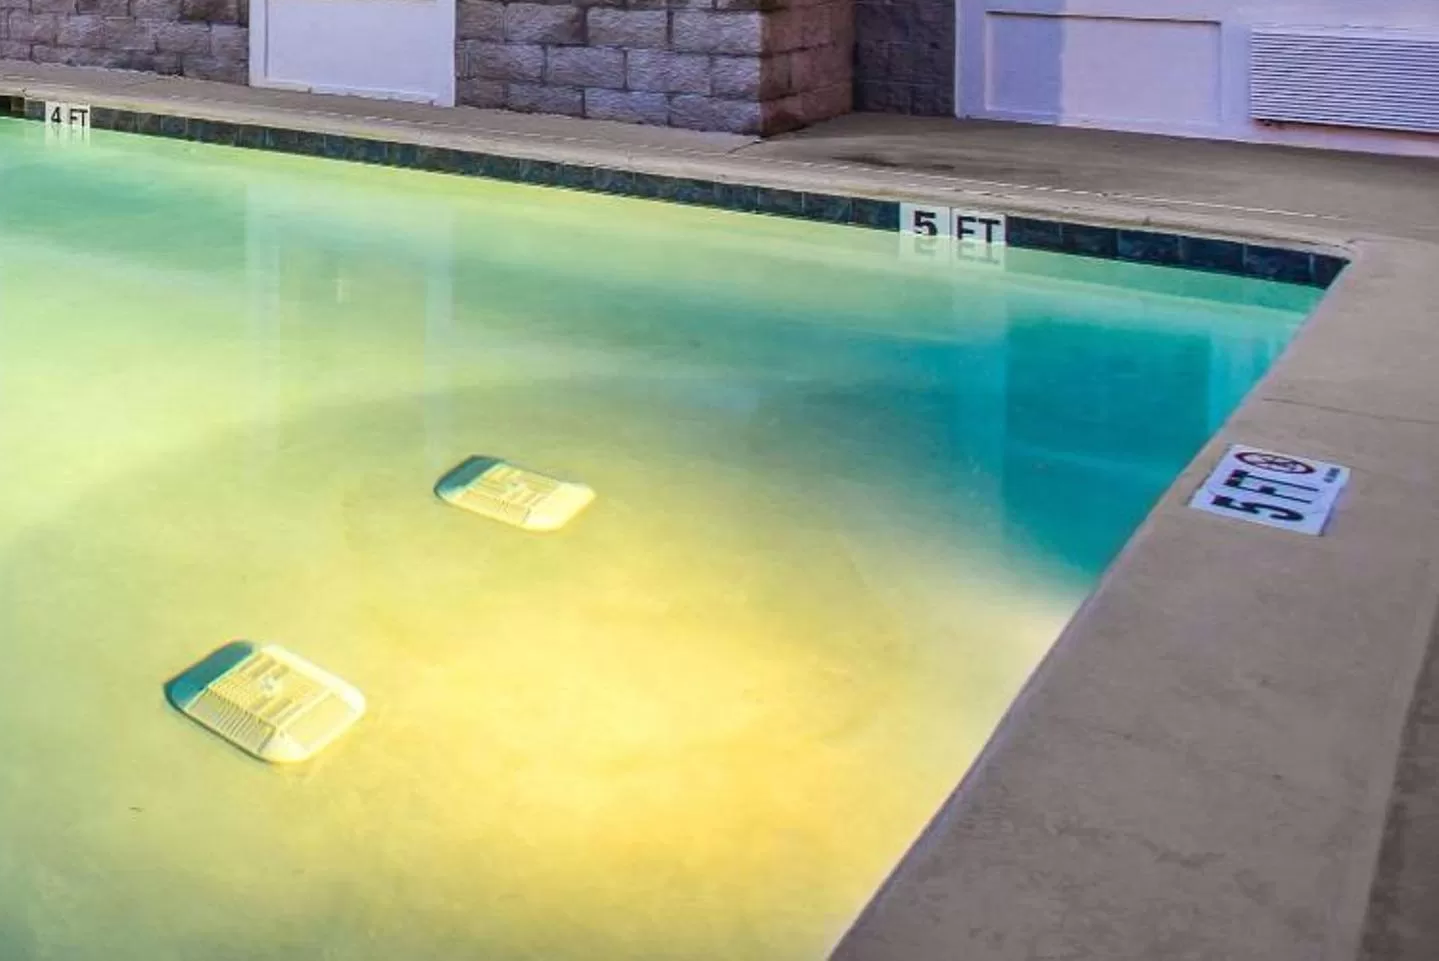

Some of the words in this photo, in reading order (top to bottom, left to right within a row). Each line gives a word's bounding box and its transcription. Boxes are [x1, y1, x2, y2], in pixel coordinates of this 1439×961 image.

[50, 106, 62, 123] 4
[69, 107, 88, 127] FT
[913, 209, 938, 236] 5
[957, 215, 1002, 244] FT
[1224, 468, 1320, 505] FT
[1211, 494, 1304, 522] 5
